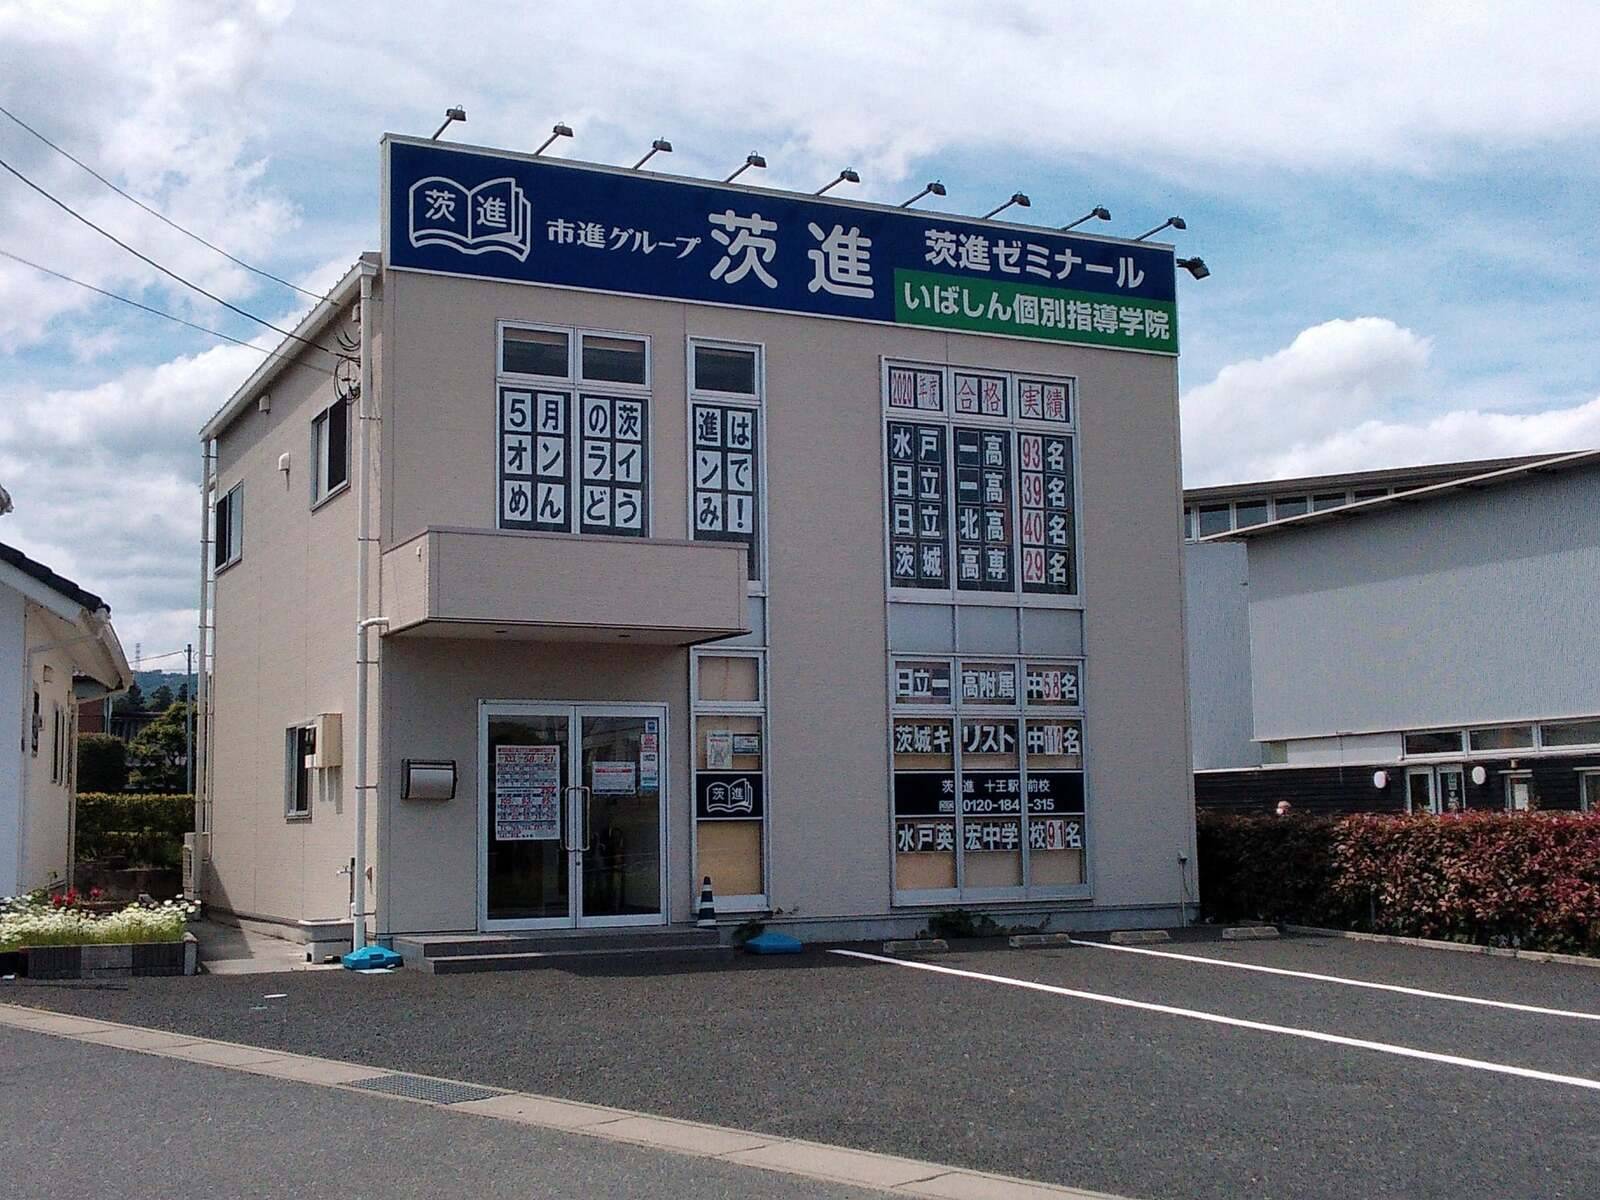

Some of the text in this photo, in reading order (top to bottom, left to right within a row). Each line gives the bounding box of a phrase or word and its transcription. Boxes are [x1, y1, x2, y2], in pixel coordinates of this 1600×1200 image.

[424, 189, 507, 228] 茨進
[546, 219, 702, 259] 市進グループ
[708, 210, 875, 299] 茨進
[924, 229, 1145, 289] 茨進ゼミナール
[904, 282, 1171, 341] いばしん個別指導学院
[894, 428, 1064, 471] 水戸一高93名
[893, 465, 1065, 508] 日立一高39名
[894, 504, 1066, 546] 日立北高40名
[895, 545, 1066, 583] 茨城高専29名
[712, 787, 744, 800] 茨進
[963, 798, 1055, 812] 0120-184-315
